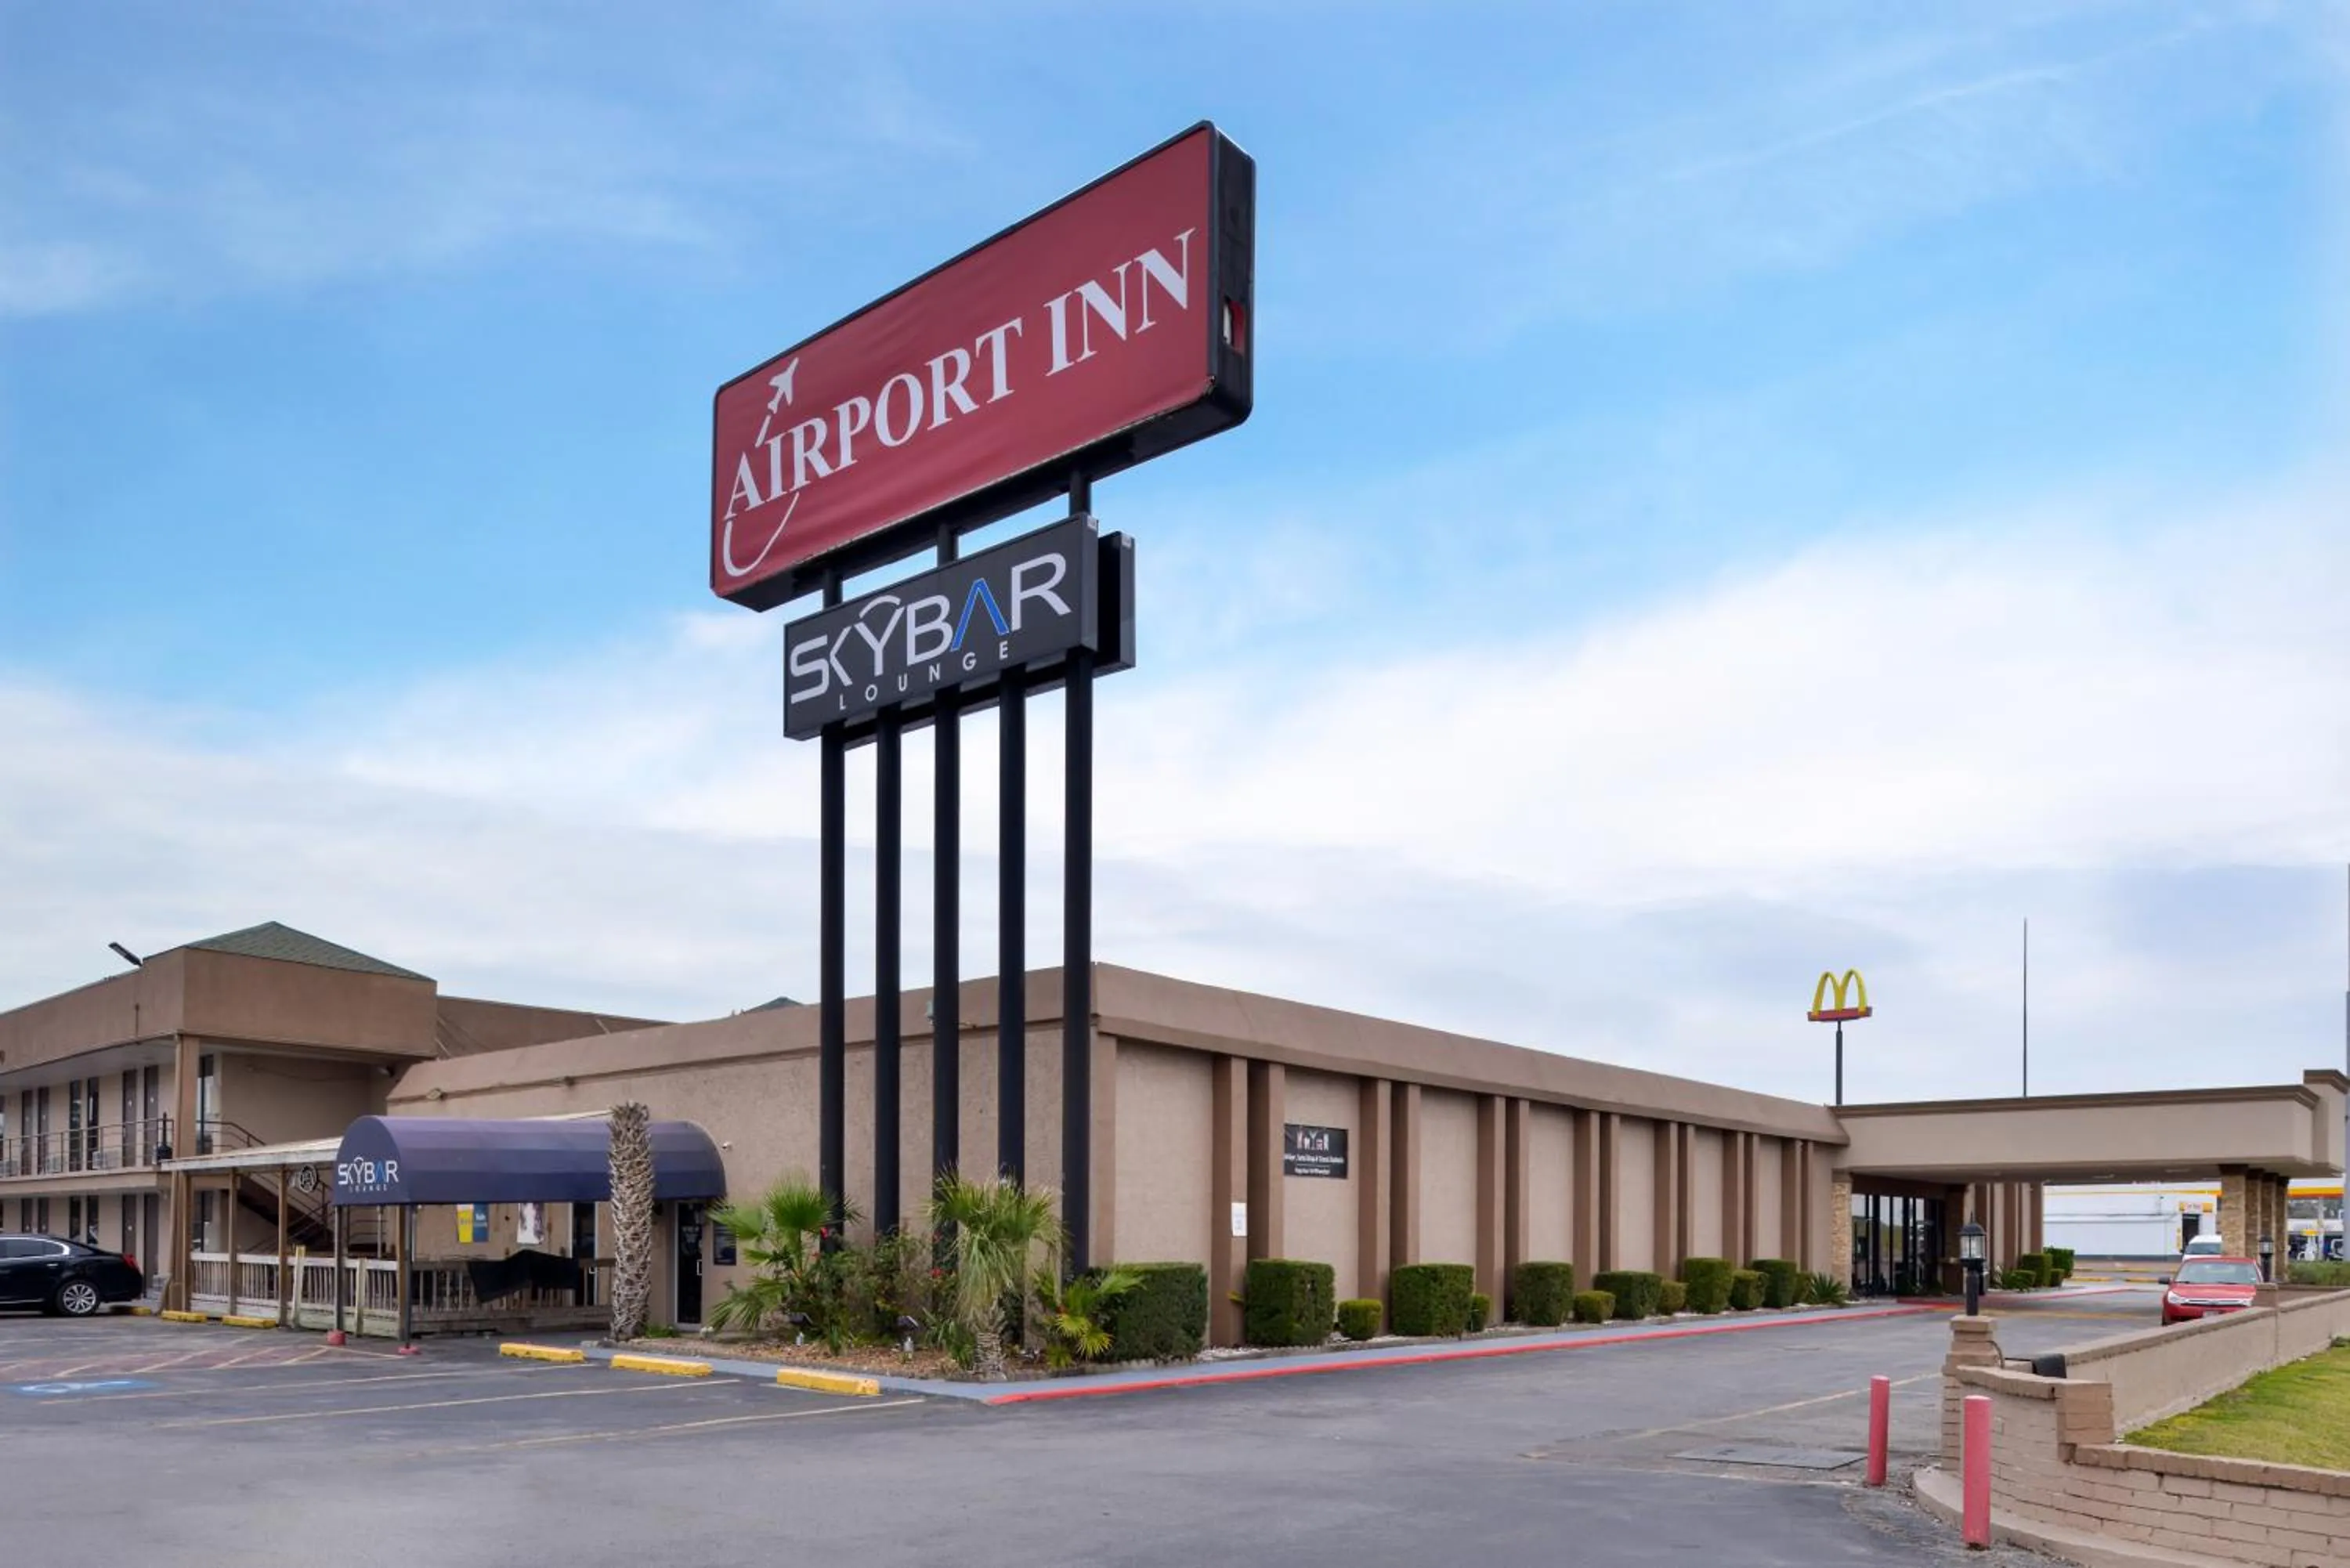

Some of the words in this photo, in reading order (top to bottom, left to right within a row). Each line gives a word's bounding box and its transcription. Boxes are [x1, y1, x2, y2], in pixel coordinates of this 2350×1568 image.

[724, 317, 1025, 521] AIRPORT
[1044, 227, 1196, 378] INN
[790, 552, 1072, 705] SKYBAR
[838, 640, 1009, 710] LOUNGE
[338, 1157, 400, 1185] SKYBAR
